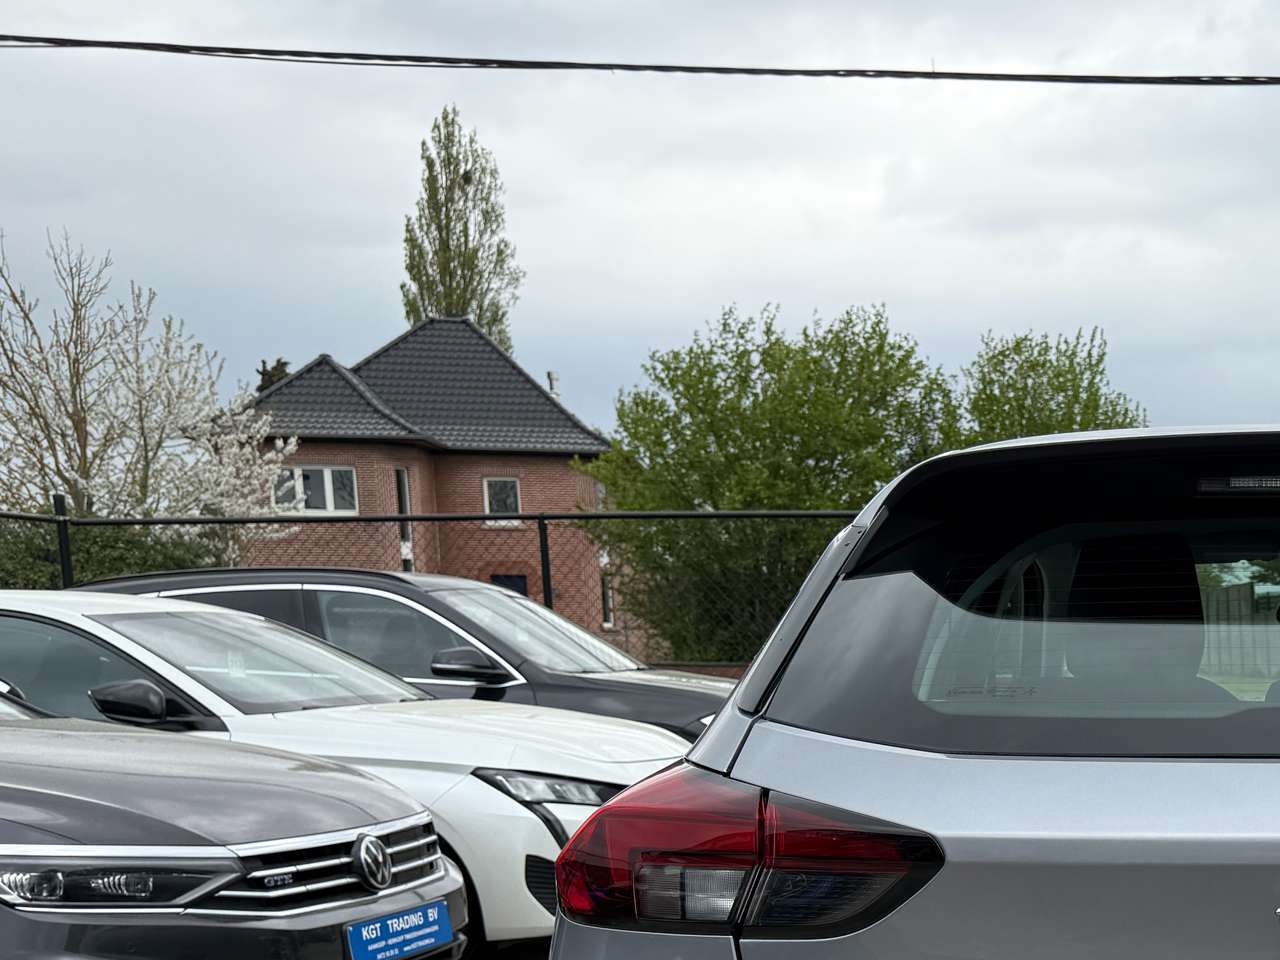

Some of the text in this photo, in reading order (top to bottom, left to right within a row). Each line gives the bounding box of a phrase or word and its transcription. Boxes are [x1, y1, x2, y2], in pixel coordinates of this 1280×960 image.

[361, 923, 382, 941] KGT
[387, 911, 424, 933] TRADING
[427, 907, 439, 922] BV
